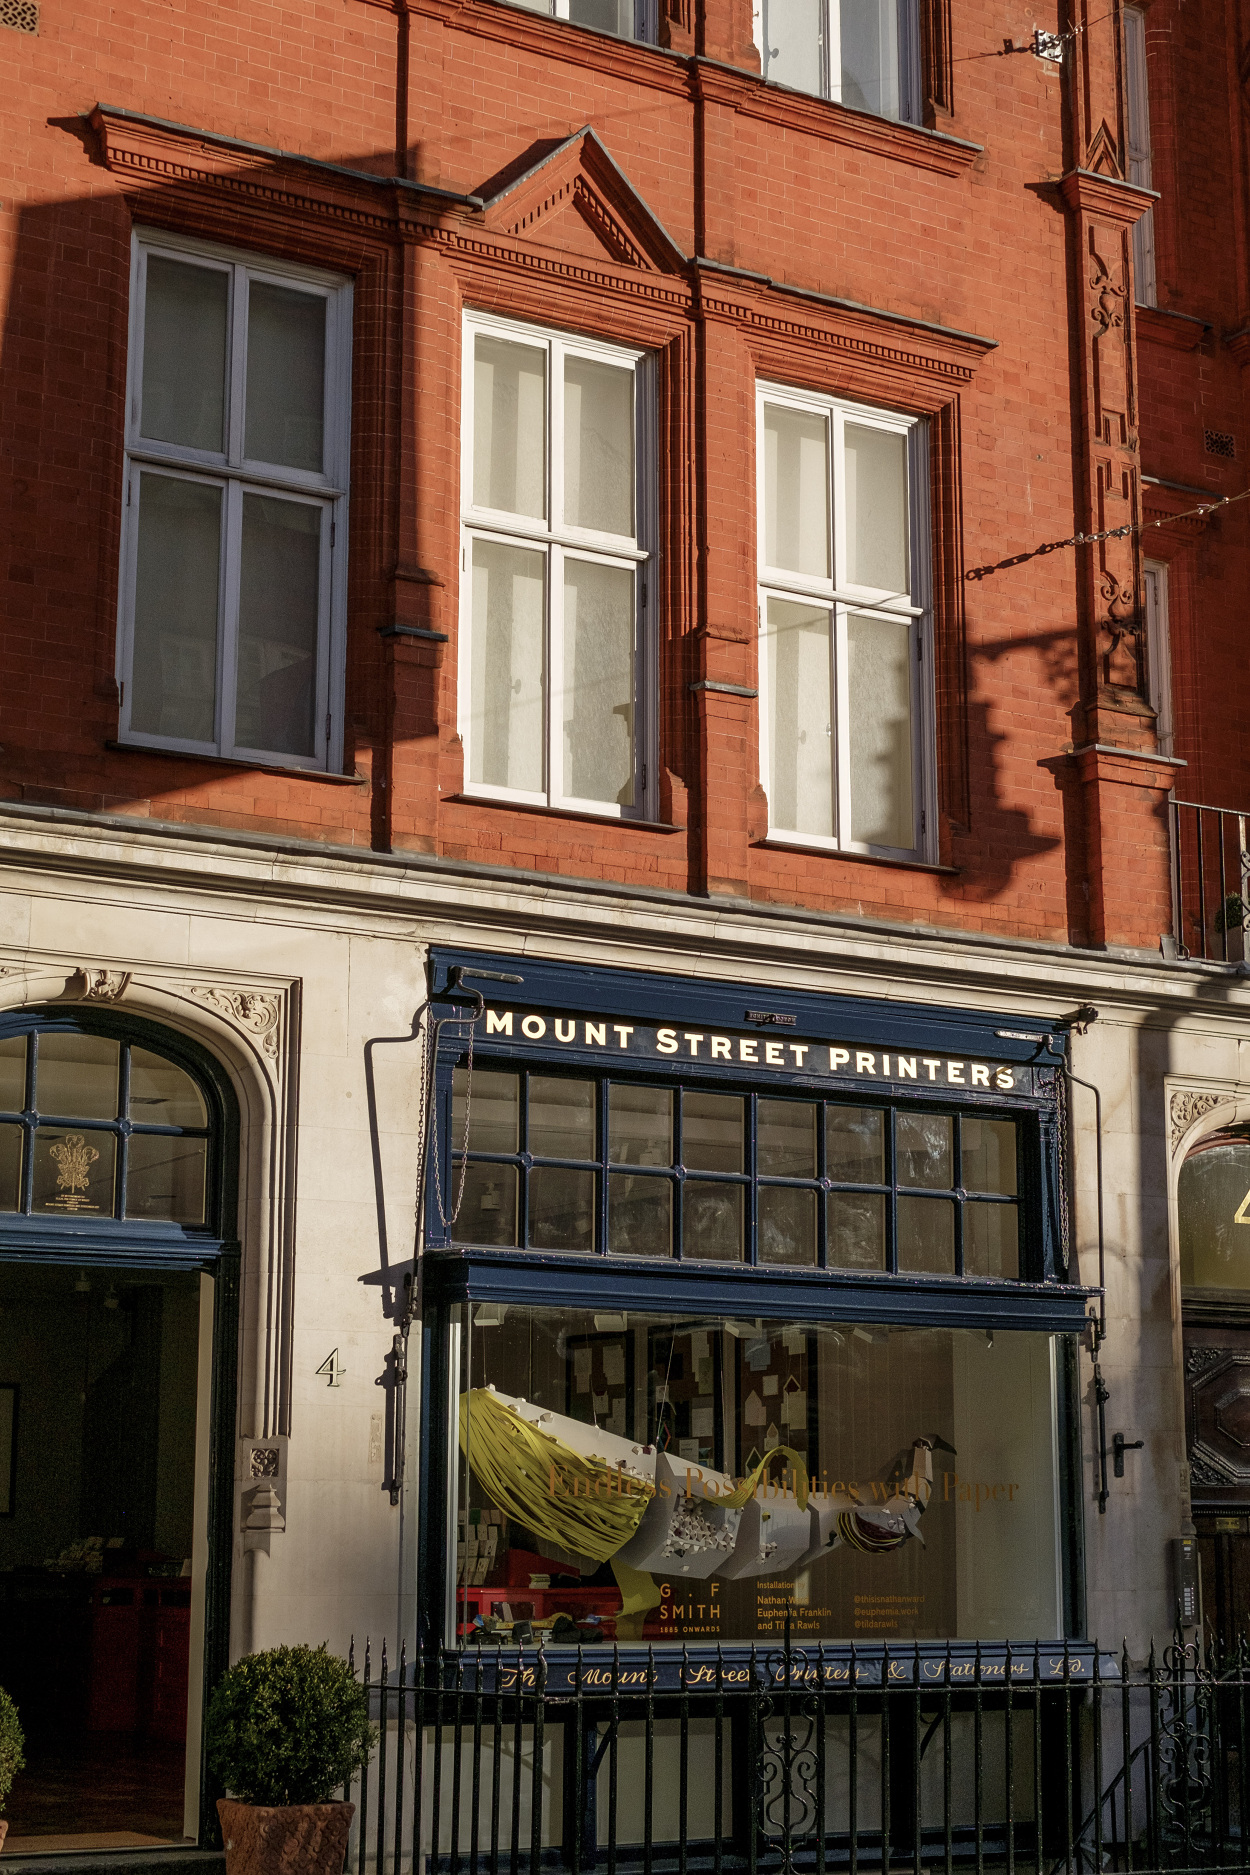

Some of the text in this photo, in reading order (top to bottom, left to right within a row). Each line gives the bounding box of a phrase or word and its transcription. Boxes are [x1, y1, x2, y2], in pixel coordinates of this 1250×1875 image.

[486, 1009, 1014, 1089] MOUNT STREET PRINTERS
[315, 1347, 347, 1388] 4
[550, 1465, 1020, 1513] Endless Possibilities with Paper
[756, 1581, 795, 1589] Installation
[757, 1596, 786, 1605] Nathan
[660, 1604, 720, 1619] SMITH
[799, 1608, 832, 1617] Franklin
[682, 1625, 720, 1633] ONWARDS
[757, 1620, 820, 1630] and Tila Rawls
[501, 1667, 548, 1687] Th
[887, 1661, 907, 1679] &
